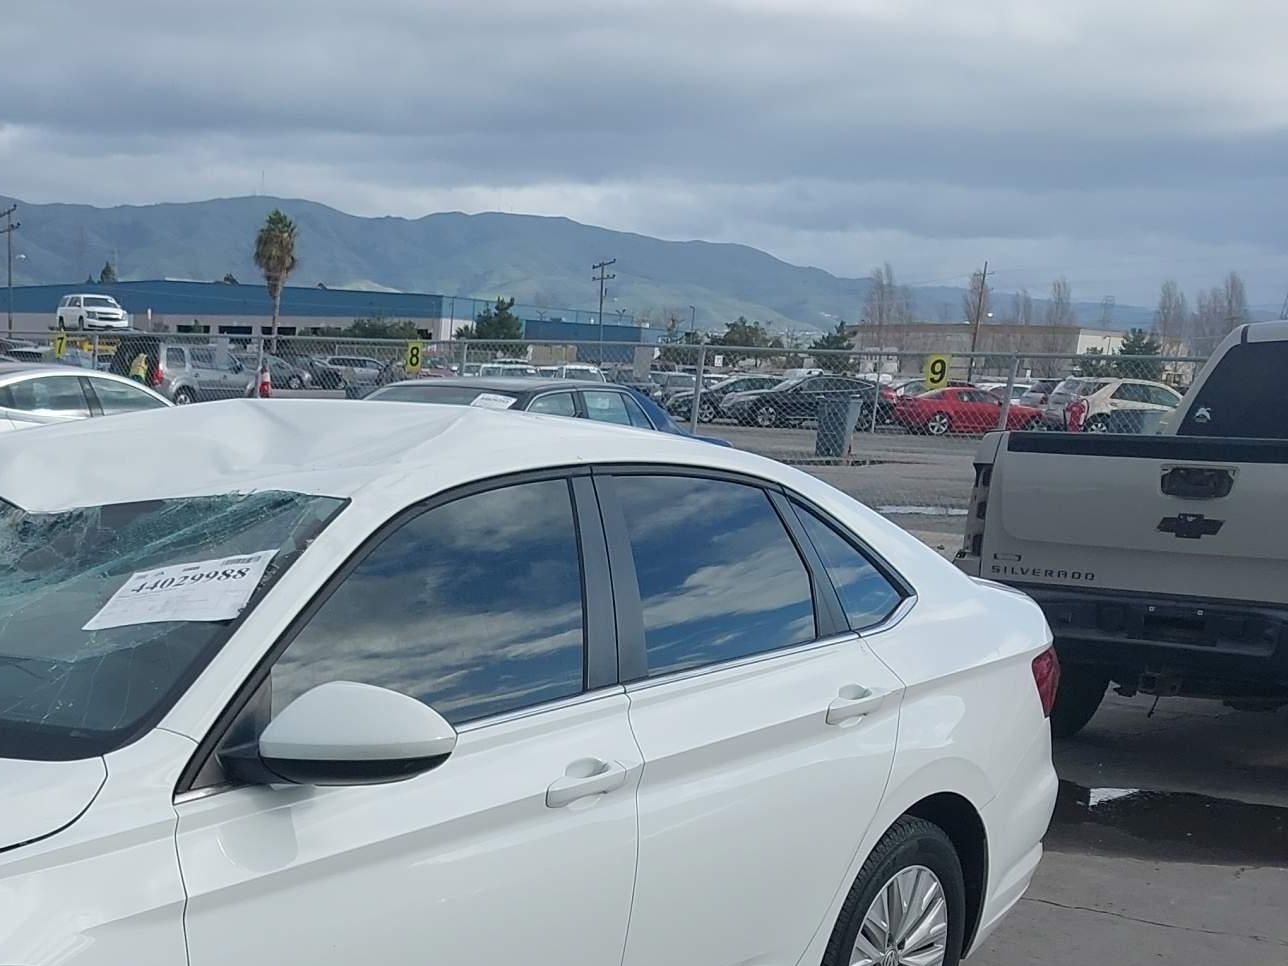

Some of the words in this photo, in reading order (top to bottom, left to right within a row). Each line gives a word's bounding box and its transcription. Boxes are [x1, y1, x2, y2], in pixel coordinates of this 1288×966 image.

[56, 336, 65, 355] 7
[409, 346, 420, 367] 8
[929, 358, 947, 384] 9
[131, 566, 251, 593] 44029988
[991, 565, 1095, 581] SILVERADO
